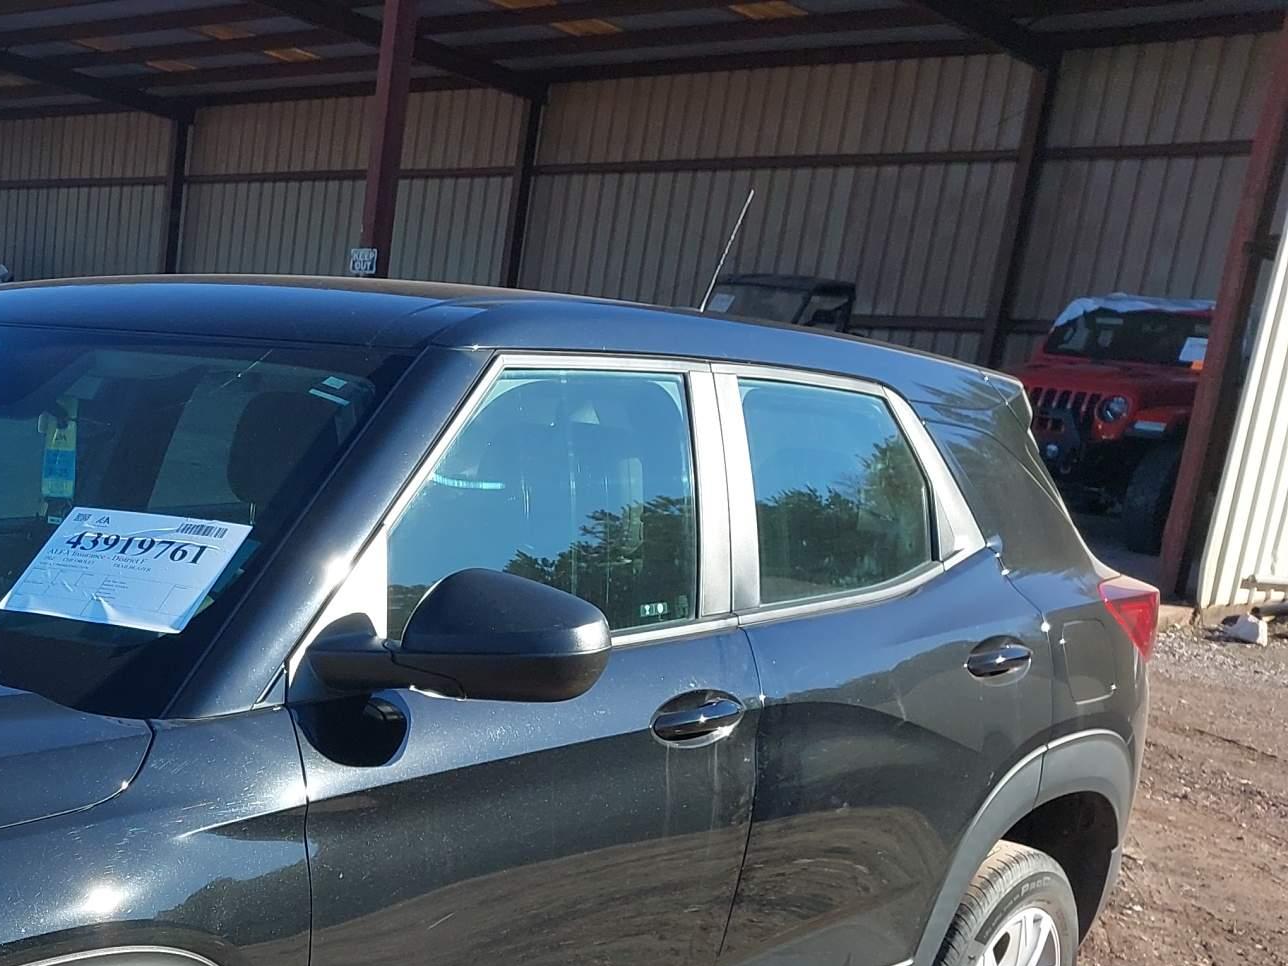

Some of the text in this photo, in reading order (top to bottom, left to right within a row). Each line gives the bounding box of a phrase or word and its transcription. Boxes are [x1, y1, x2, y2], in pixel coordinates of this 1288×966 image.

[353, 250, 375, 260] KEEP
[354, 260, 372, 271] OUT
[65, 531, 208, 565] 43919761
